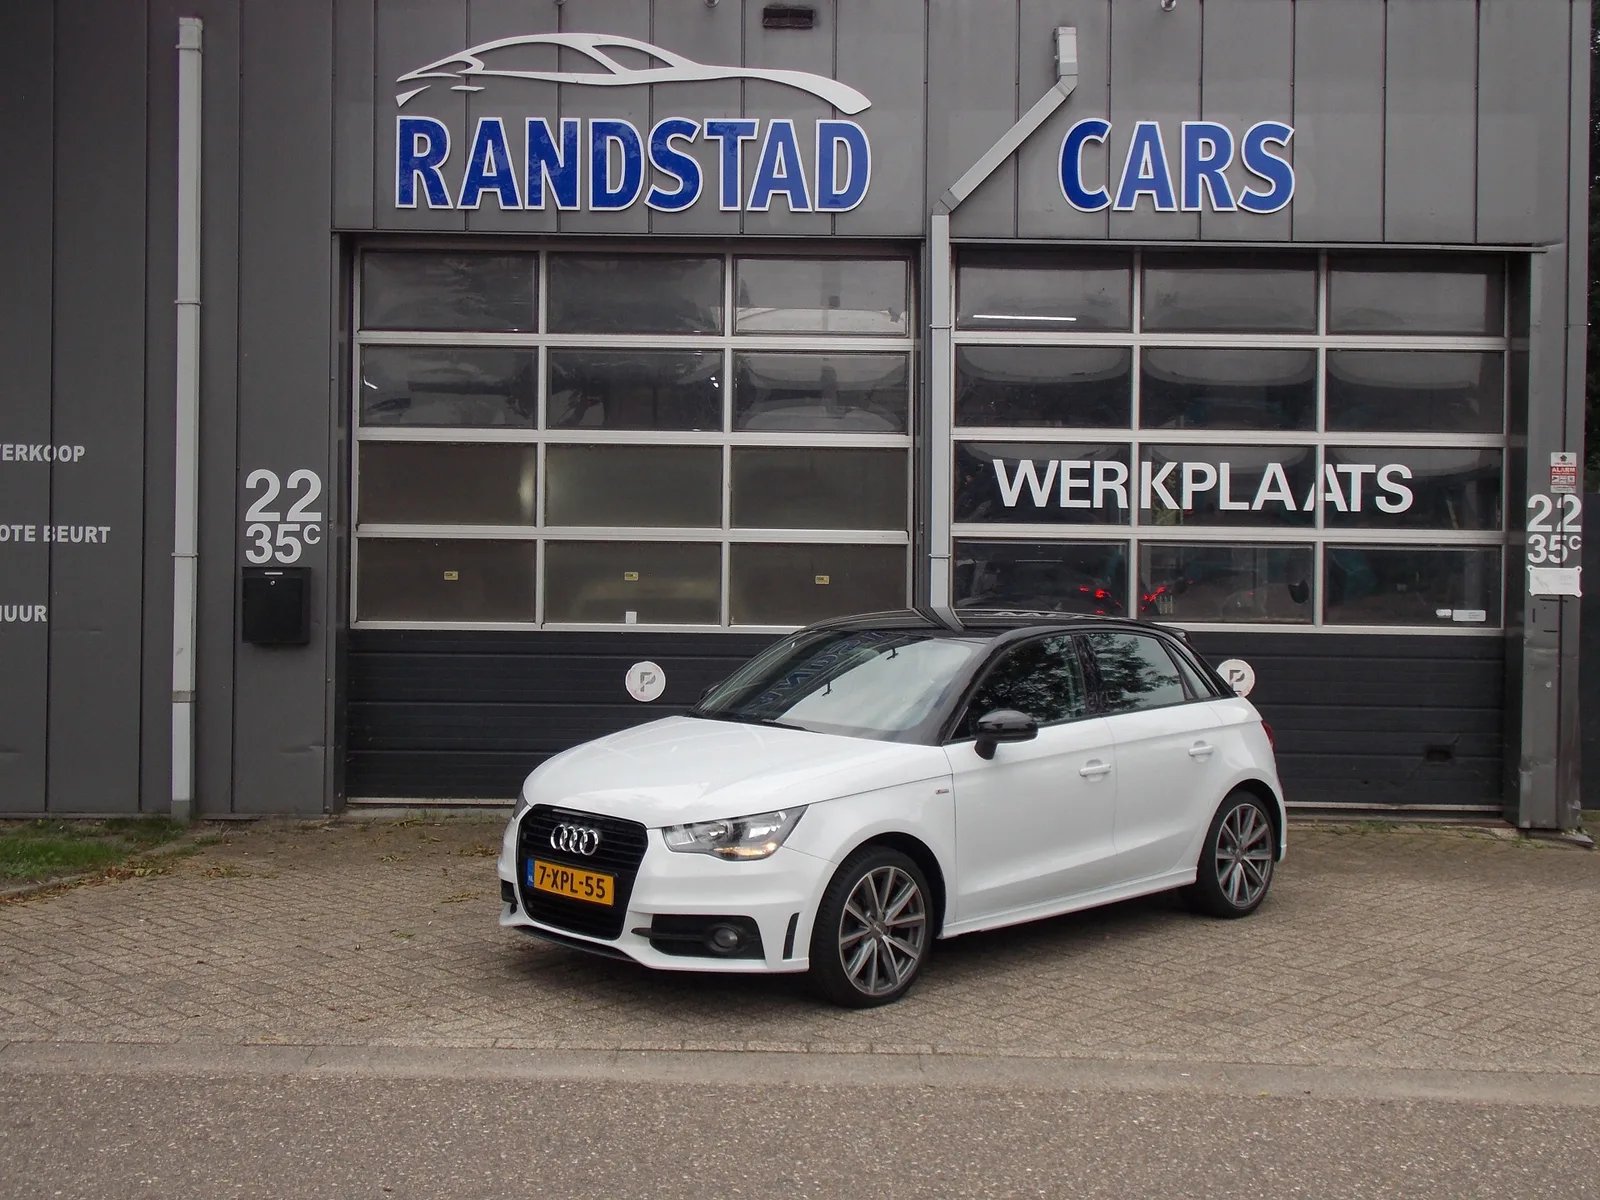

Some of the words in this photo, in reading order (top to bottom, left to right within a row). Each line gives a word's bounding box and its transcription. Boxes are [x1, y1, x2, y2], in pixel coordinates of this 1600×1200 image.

[395, 115, 872, 213] RANDSTAD
[1058, 118, 1295, 214] CARS
[0, 443, 85, 463] ERKOOP
[245, 469, 322, 522] 22
[992, 458, 1414, 514] WERKPLAATS
[1527, 494, 1582, 532] 22
[43, 525, 111, 543] BEURT
[0, 604, 48, 622] UUR
[538, 865, 606, 899] 7-XPL-55
